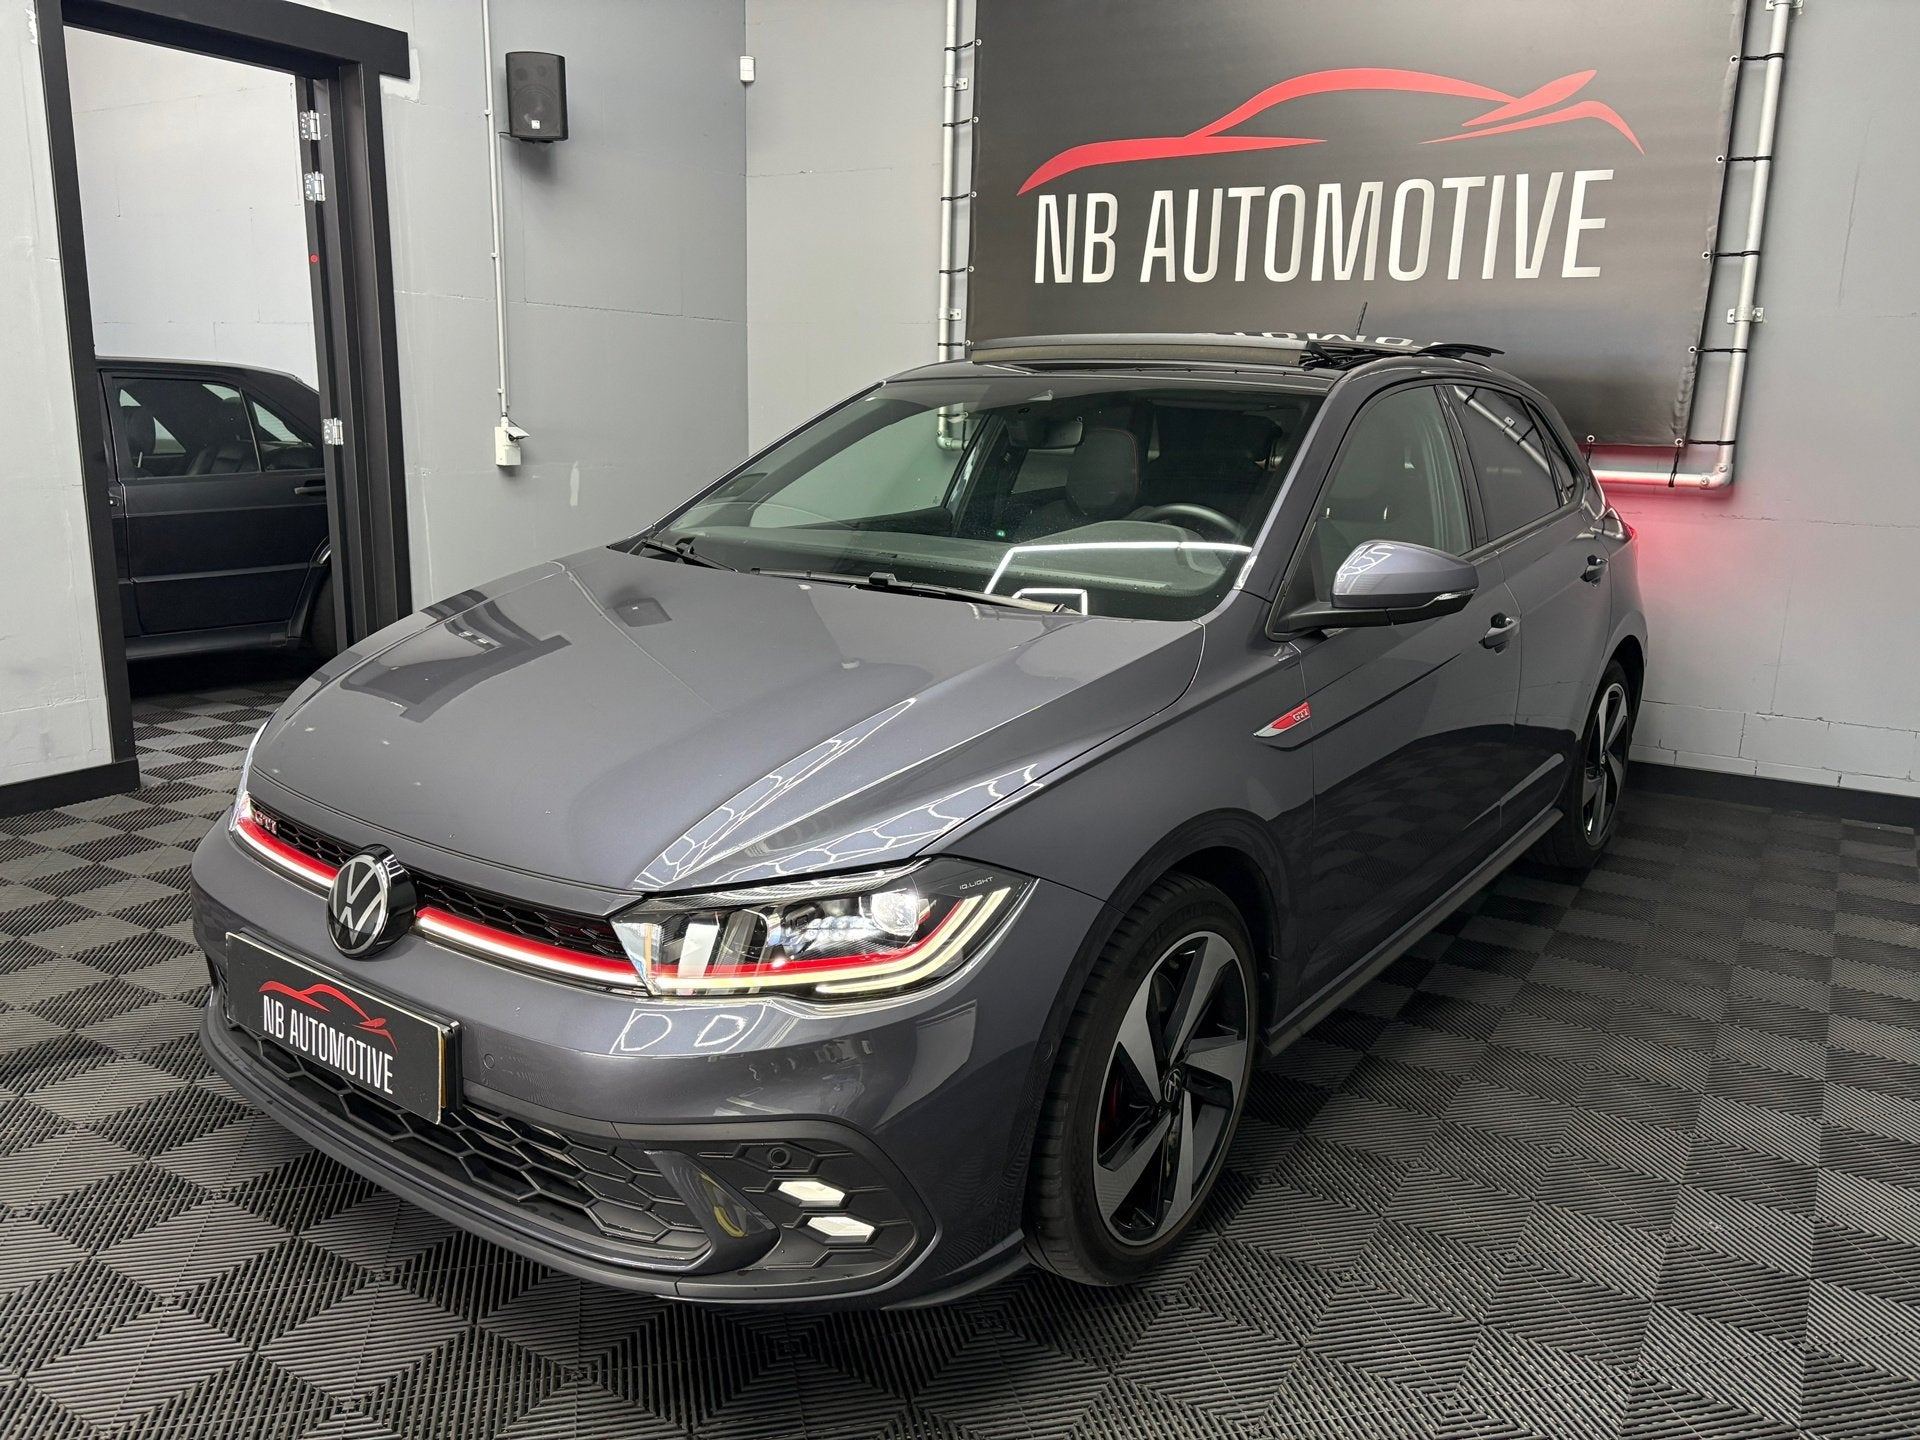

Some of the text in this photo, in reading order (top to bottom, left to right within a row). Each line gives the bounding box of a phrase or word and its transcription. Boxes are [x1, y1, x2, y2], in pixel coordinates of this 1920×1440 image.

[1034, 169, 1614, 284] NB AUTOMOTIVE
[1293, 708, 1309, 721] GTI
[255, 811, 277, 835] GTI
[263, 995, 394, 1095] NB AUTOMOTIVE
